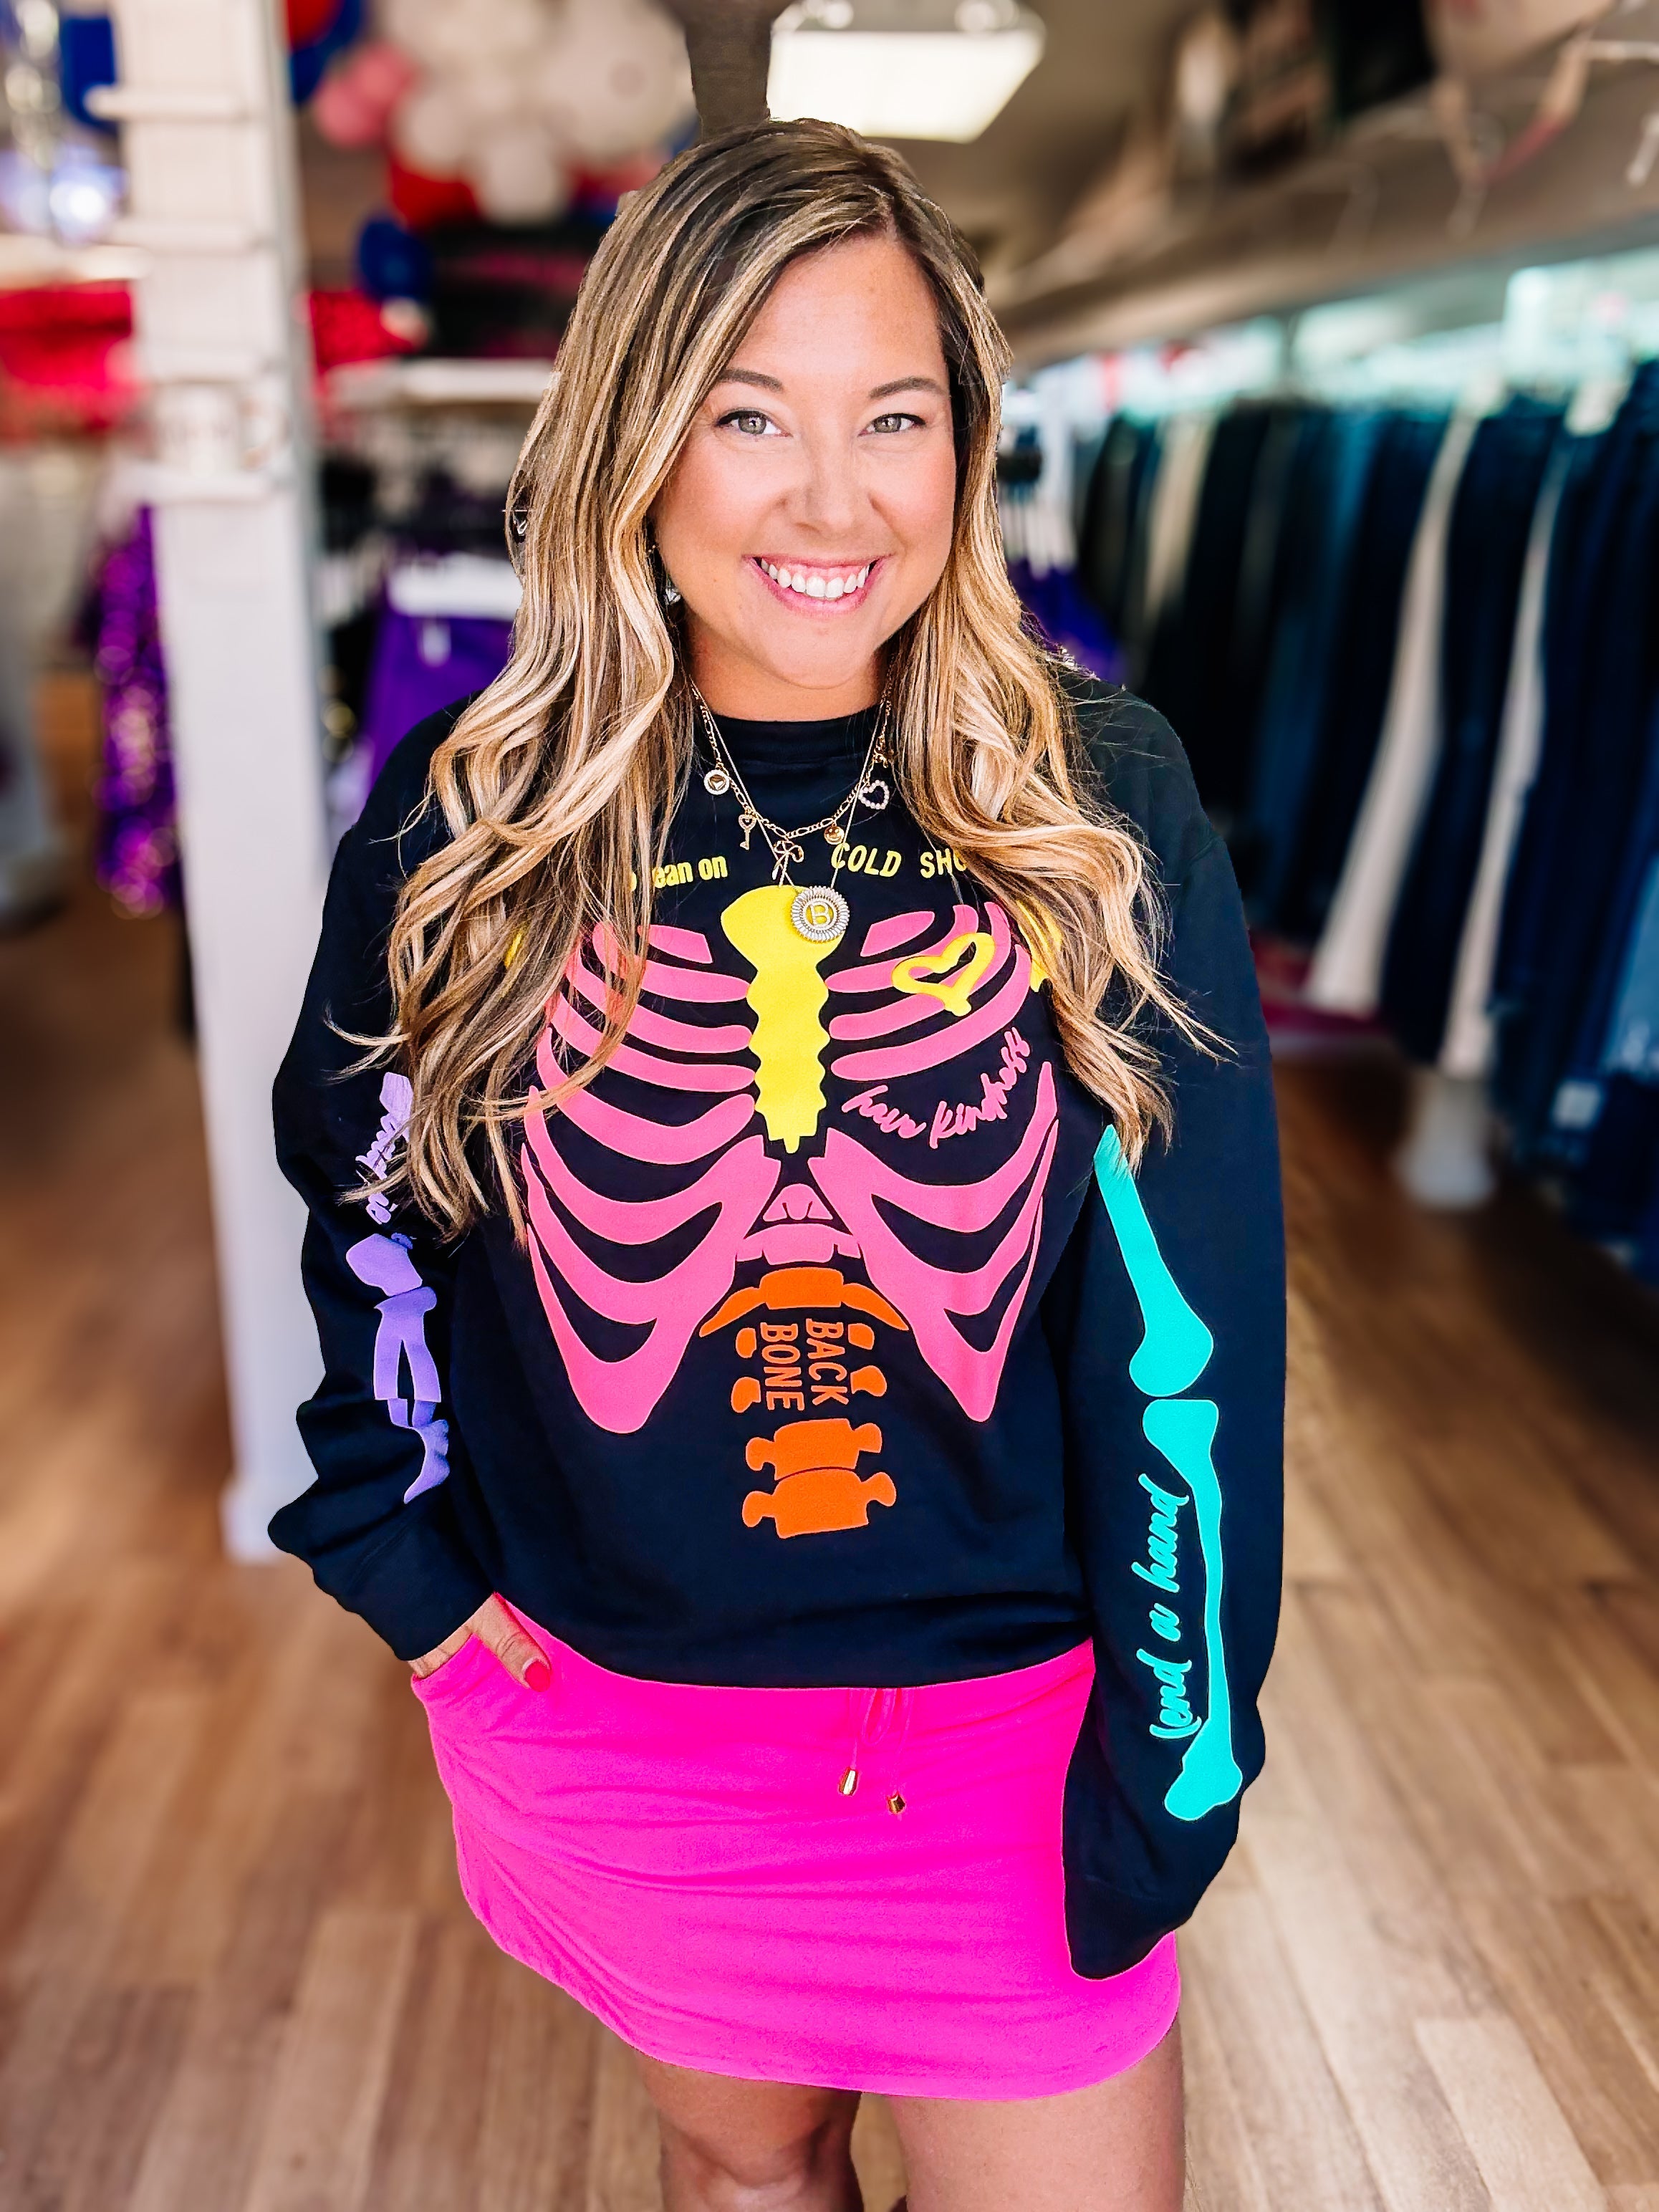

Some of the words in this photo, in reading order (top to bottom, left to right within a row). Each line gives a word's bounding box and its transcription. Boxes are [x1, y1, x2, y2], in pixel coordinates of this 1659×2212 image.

[698, 855, 728, 881] on
[831, 842, 902, 877] COLD
[810, 901, 832, 927] B
[929, 1026, 1031, 1150] kindness
[760, 1322, 805, 1411] BONE
[805, 1317, 850, 1406] BACK
[1131, 1473, 1190, 1593] hand
[1149, 1602, 1181, 1642] a
[1136, 1648, 1203, 1739] lend
